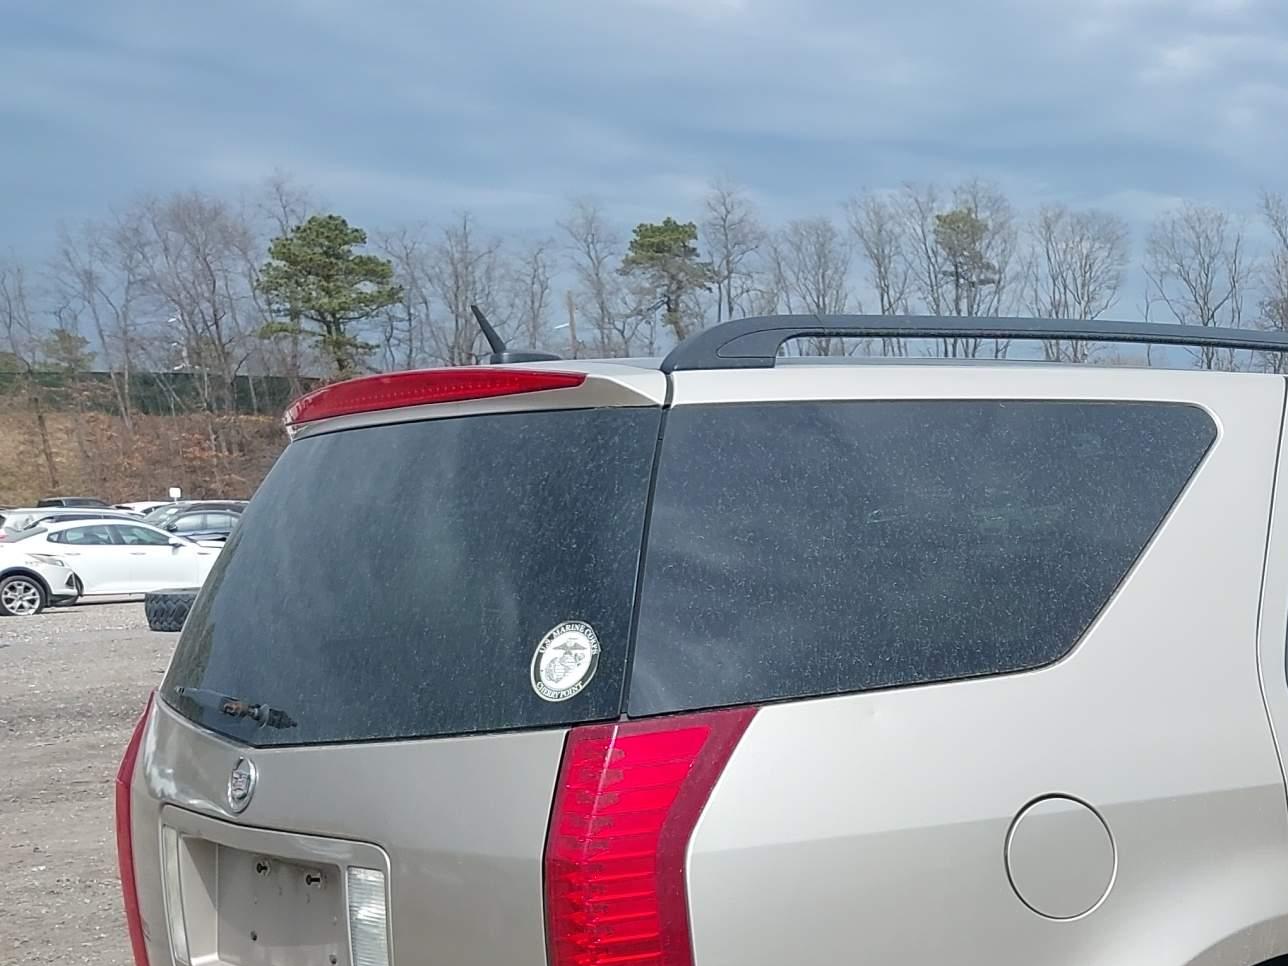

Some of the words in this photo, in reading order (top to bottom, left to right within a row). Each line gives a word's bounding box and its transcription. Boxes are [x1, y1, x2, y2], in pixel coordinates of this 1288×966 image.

[553, 624, 586, 637] MARINE
[586, 629, 598, 654] CORPS
[537, 682, 560, 698] CHERRY
[560, 681, 584, 698] POINT
